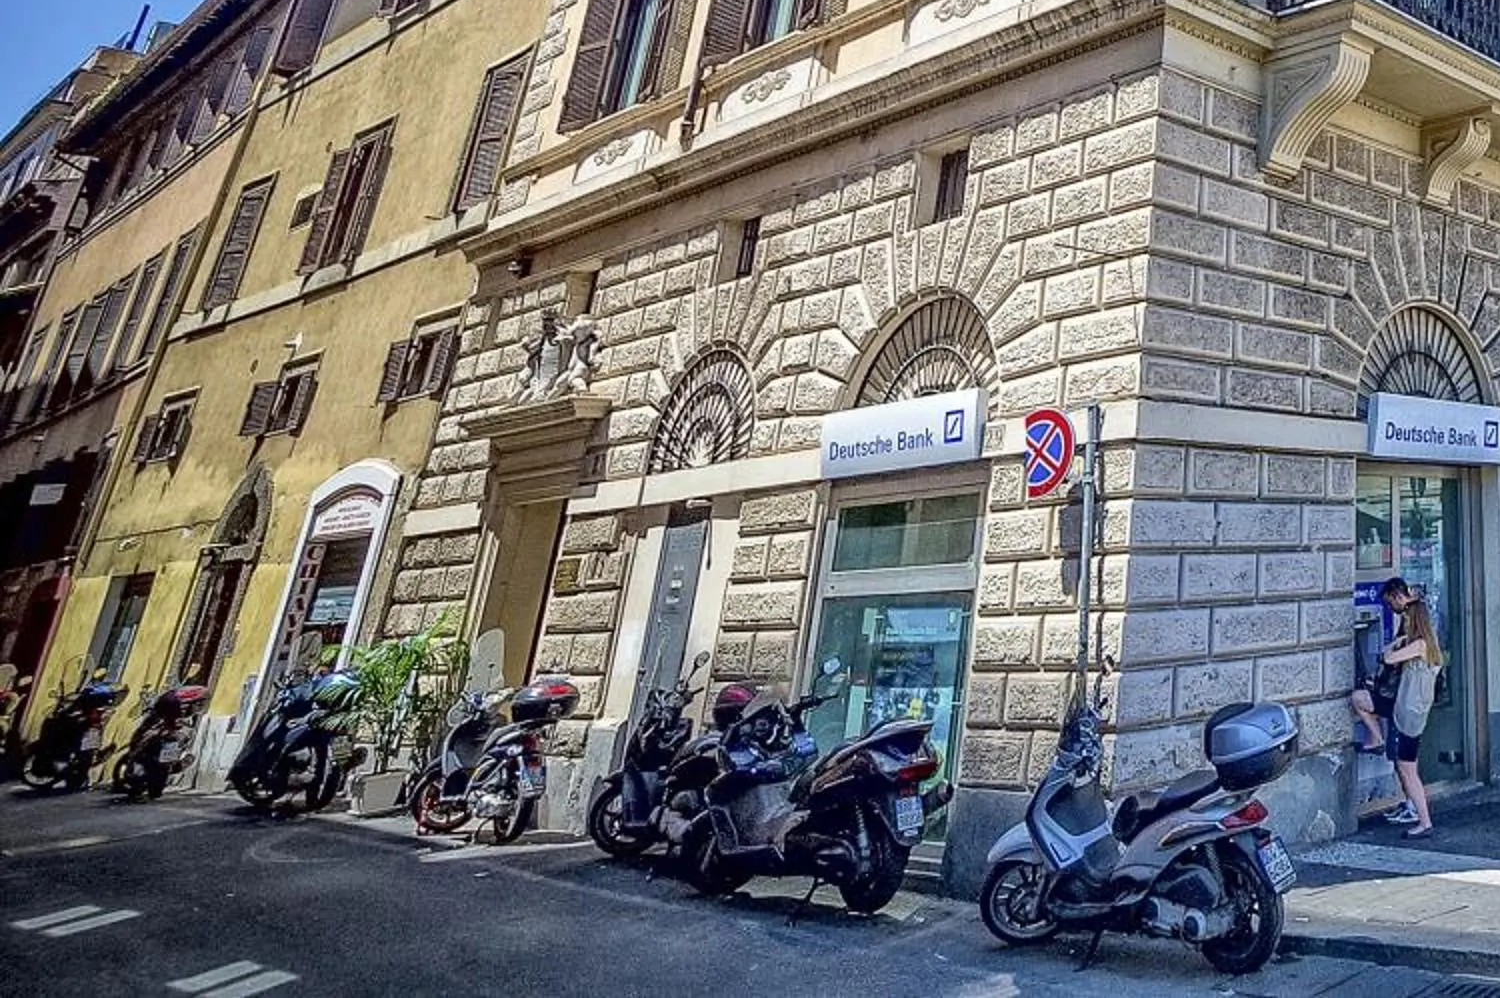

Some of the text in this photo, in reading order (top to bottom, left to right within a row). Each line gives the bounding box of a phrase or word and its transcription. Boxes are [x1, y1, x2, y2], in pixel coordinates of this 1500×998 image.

[829, 428, 934, 461] Deutsche Bank
[1385, 421, 1478, 447] Deutsche Bank
